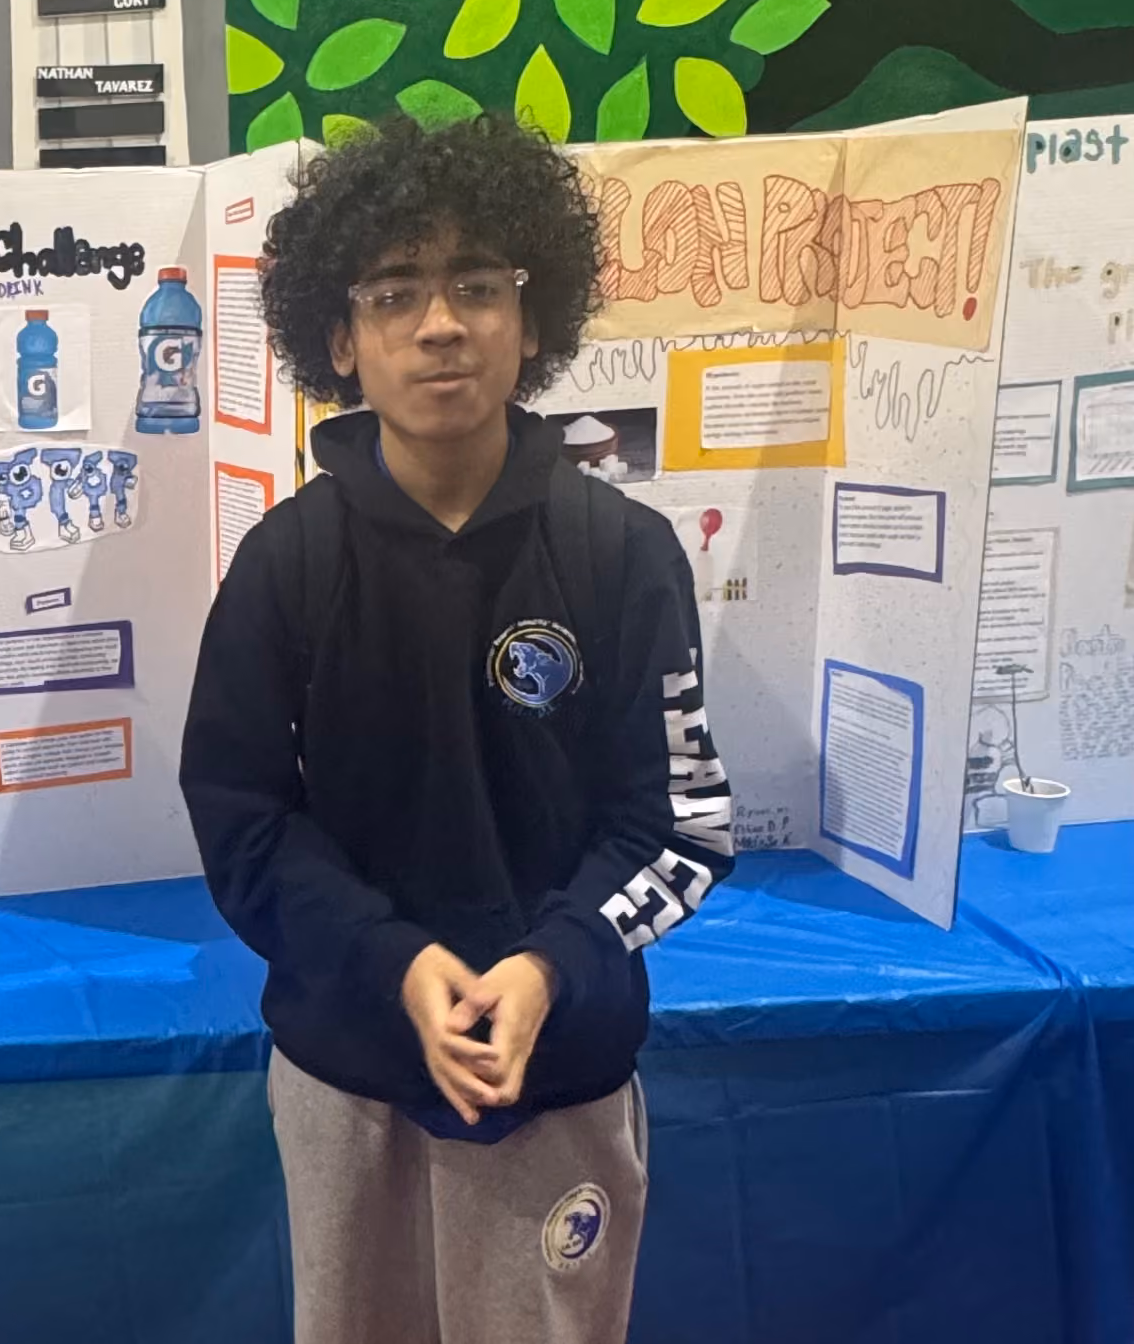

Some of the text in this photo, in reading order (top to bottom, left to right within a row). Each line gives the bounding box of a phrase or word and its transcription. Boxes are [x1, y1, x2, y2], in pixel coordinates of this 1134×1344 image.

[38, 67, 93, 79] NATHAN
[95, 80, 154, 93] TAVAREZ
[155, 338, 183, 372] G
[28, 374, 46, 396] G
